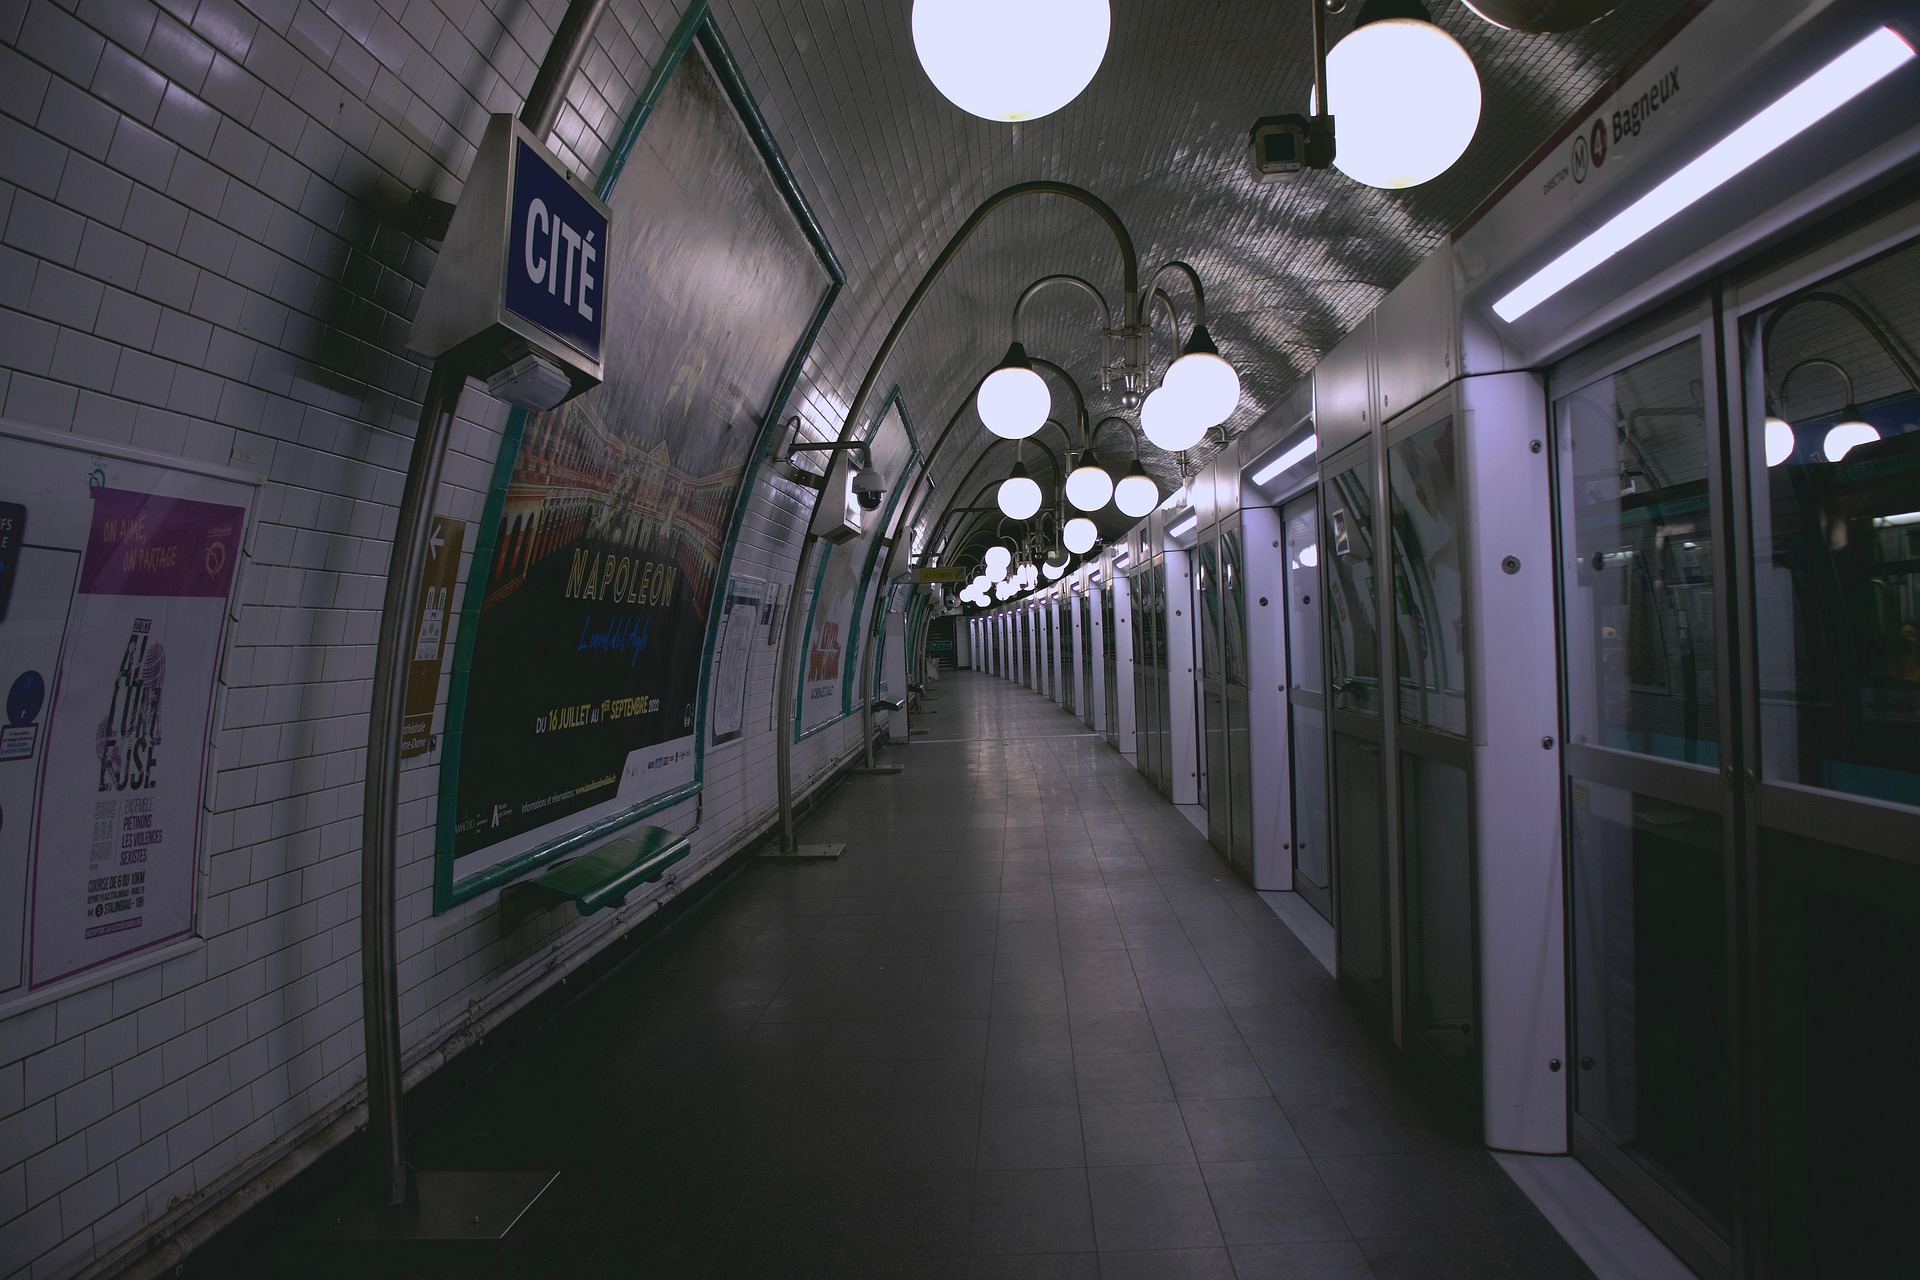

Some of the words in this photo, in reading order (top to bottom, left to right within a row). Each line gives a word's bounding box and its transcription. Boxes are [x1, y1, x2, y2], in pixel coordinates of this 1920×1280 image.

[1612, 65, 1680, 144] Bagneux
[525, 197, 597, 322] CITÉ
[0, 518, 13, 531] FS
[104, 520, 117, 543] ON
[123, 549, 136, 572] ON
[139, 545, 178, 573] PARTAGE
[565, 548, 677, 607] NAPOLEON
[535, 717, 547, 734] DU
[549, 708, 558, 732] 16
[558, 704, 590, 730] JUILLET
[591, 708, 600, 724] AU
[611, 695, 648, 720] SEPTEMBRE
[648, 699, 659, 713] 2022
[125, 797, 153, 814] ENSEMBLE
[122, 833, 133, 848] LES
[134, 829, 162, 847] VIOLENCES
[120, 848, 147, 866] SEXISTES
[88, 877, 109, 894] COURSE
[110, 875, 117, 889] DE
[122, 874, 130, 887] OU
